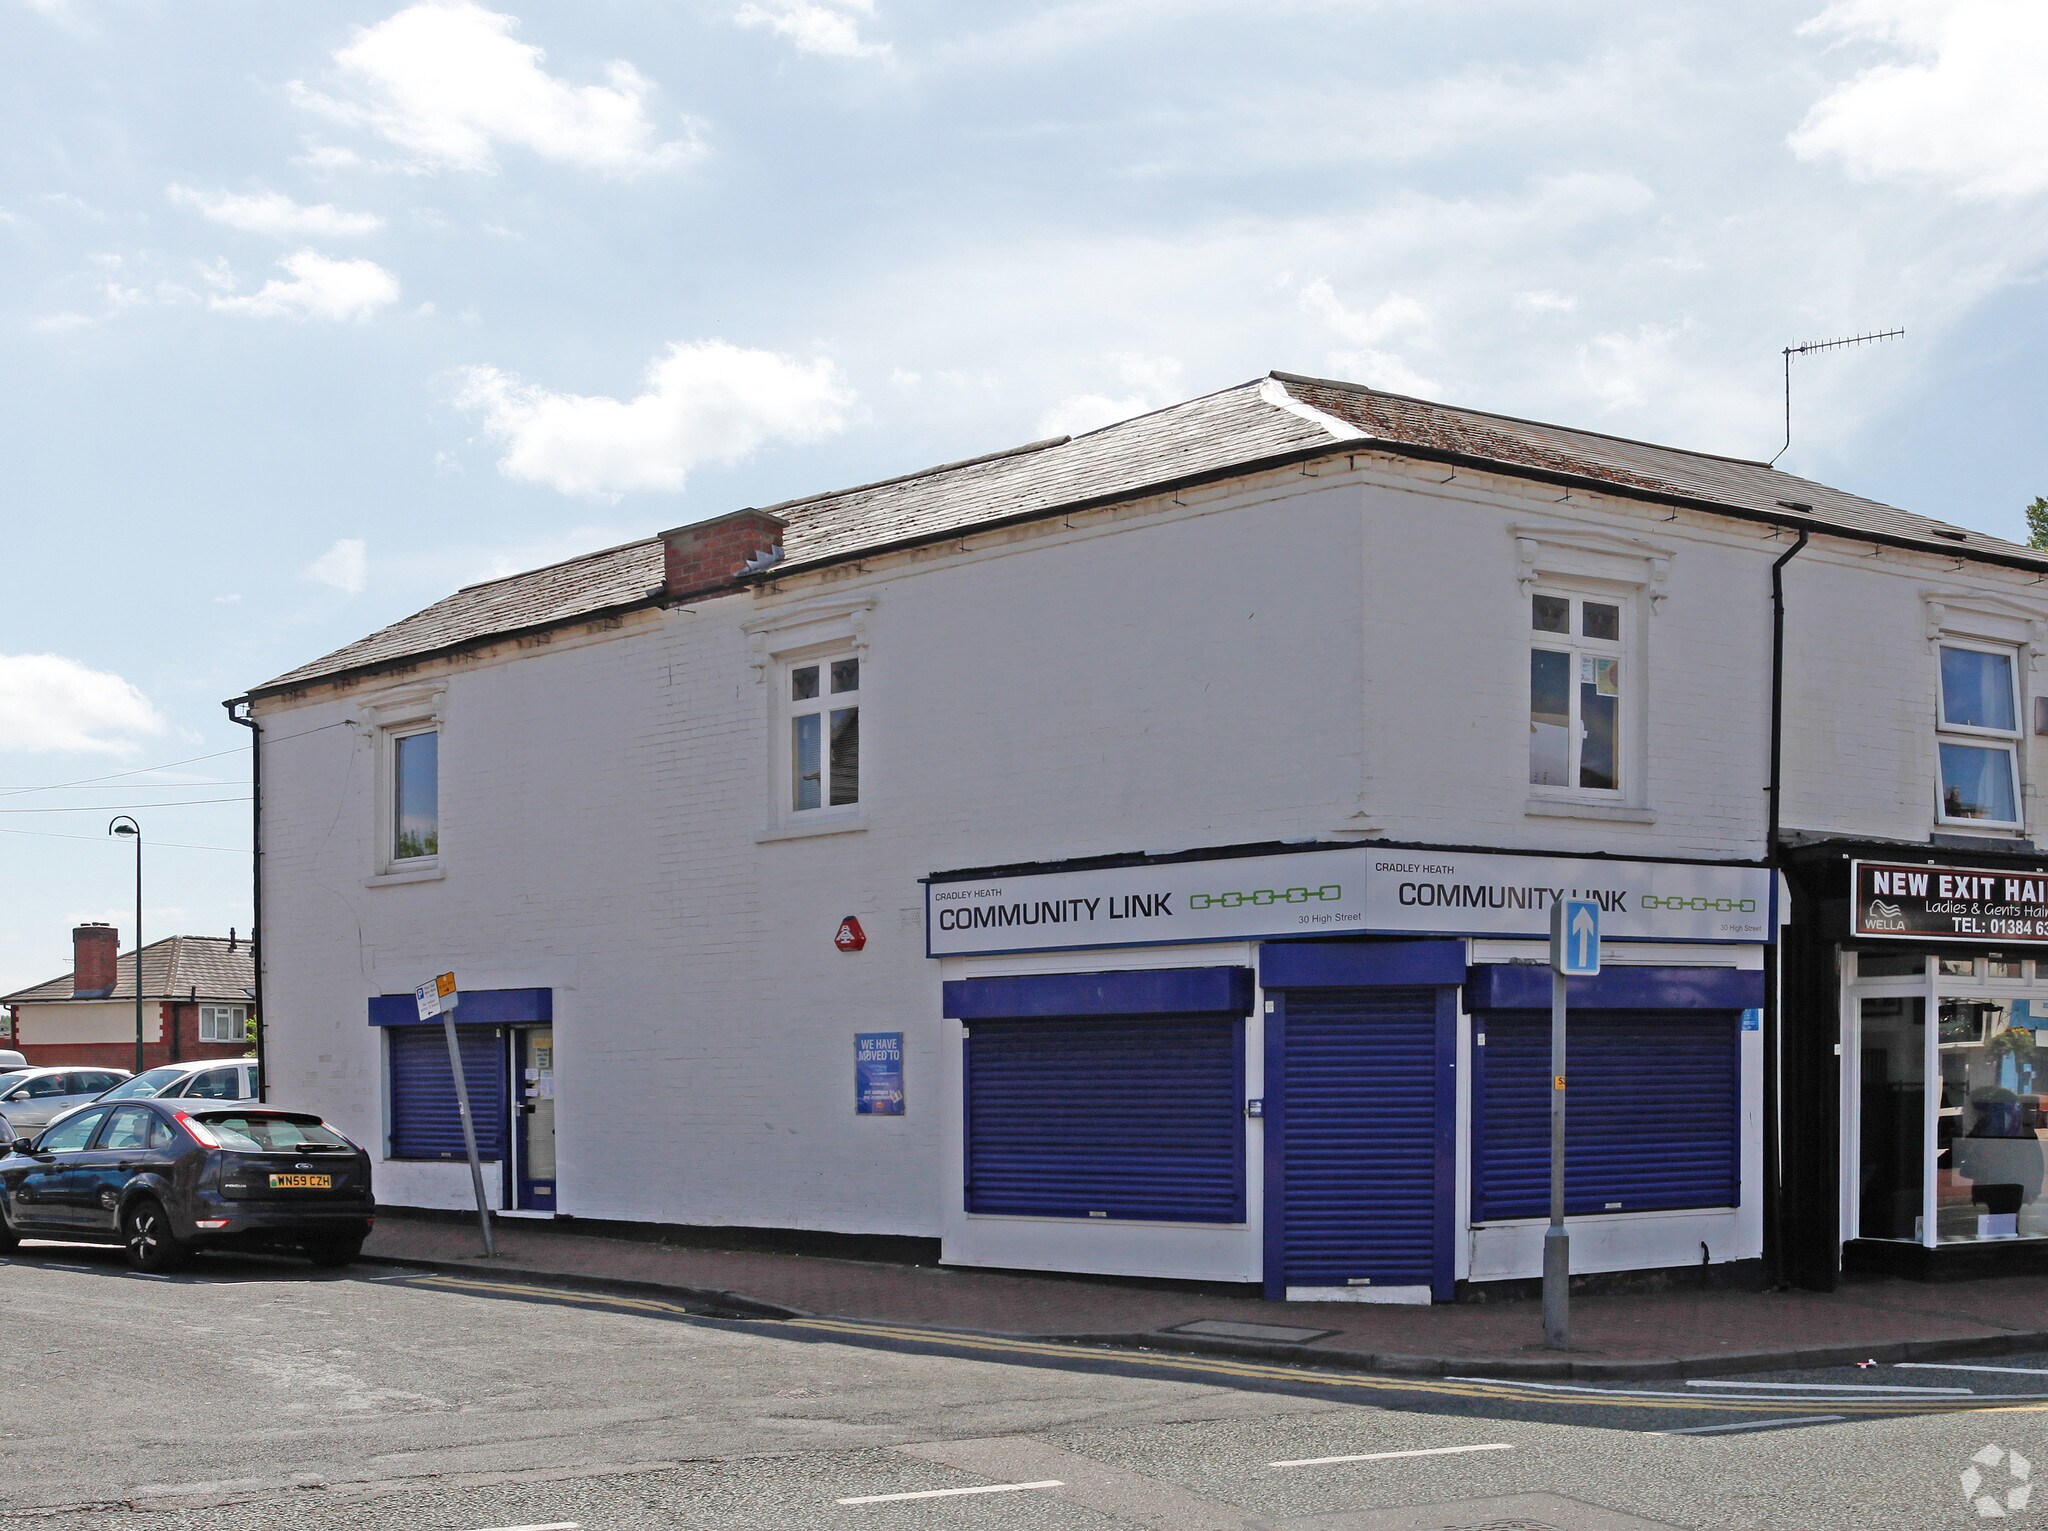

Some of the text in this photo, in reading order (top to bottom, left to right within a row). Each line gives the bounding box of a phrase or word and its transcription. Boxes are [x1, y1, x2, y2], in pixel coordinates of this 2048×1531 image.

[1375, 862, 1455, 875] CRADLEY HEATH
[1873, 871, 2048, 902] NEW EXIT HAI
[935, 888, 1002, 901] CRADLEY HEATH
[1398, 881, 1565, 910] COMMUNITY
[939, 892, 1173, 931] COMMUNITY LINK
[1925, 900, 1967, 915] Ladies
[1970, 902, 1981, 914] &
[1984, 903, 2020, 917] Gents
[1298, 912, 1362, 925] 30 High Street
[1865, 919, 1906, 931] WELLA
[1720, 923, 1762, 932] 30 High Street
[1952, 917, 1986, 934] TEL:
[1990, 918, 2032, 936] 01384
[861, 1038, 897, 1050] WE HAVE
[858, 1049, 900, 1061] MOVED TO
[278, 1176, 330, 1186] WN59 CZH
